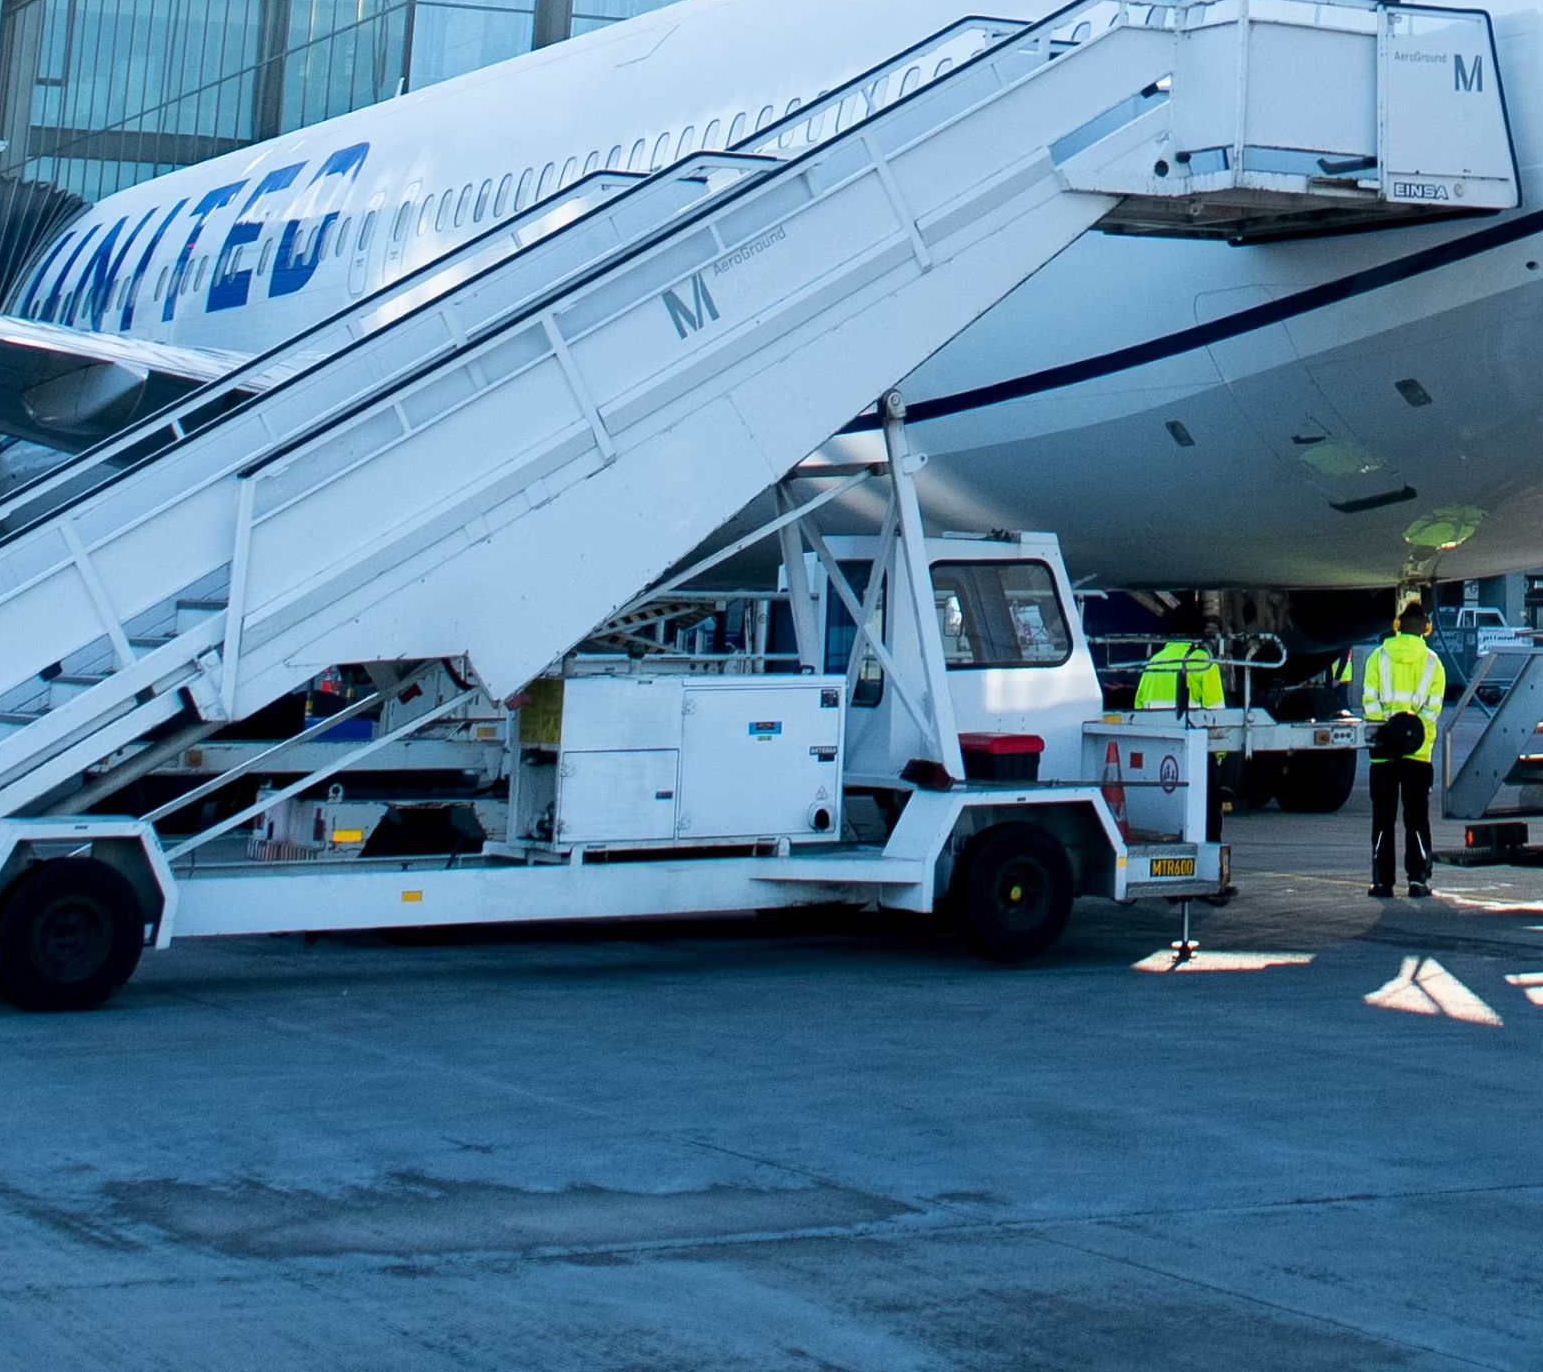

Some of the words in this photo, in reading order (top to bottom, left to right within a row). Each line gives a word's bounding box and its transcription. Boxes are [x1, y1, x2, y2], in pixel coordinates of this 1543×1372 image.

[1394, 50, 1448, 63] AeroGround
[1454, 54, 1484, 93] M
[1394, 182, 1449, 201] EINSA
[19, 142, 370, 333] UNITED
[661, 269, 720, 340] M
[713, 224, 788, 276] AeroGround
[1152, 859, 1194, 875] MTR600
